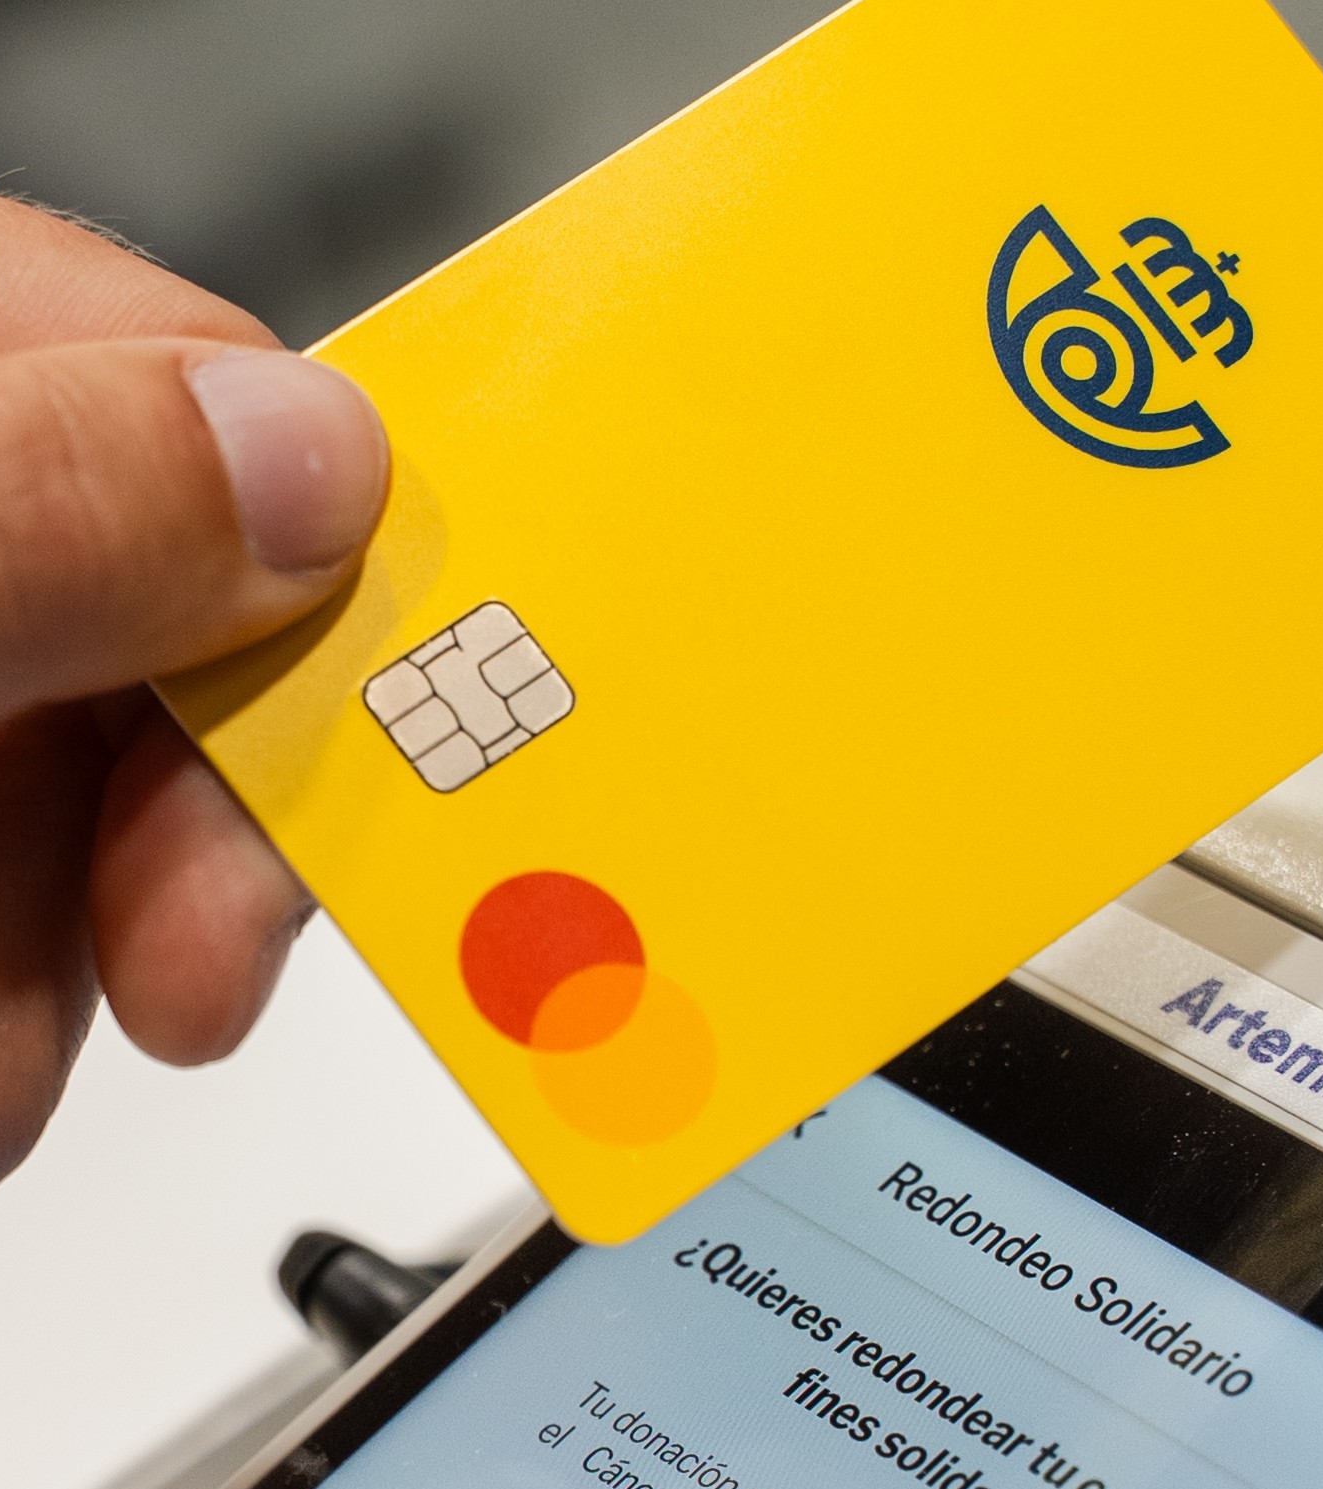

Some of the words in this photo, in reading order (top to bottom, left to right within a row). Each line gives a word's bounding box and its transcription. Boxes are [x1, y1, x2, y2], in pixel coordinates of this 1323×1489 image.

[879, 1160, 1074, 1291] Redondeo
[1074, 1276, 1255, 1399] Solidario
[578, 1380, 616, 1421] Tu
[674, 1237, 842, 1344] ¿Quieres
[835, 1330, 1036, 1458] redondear
[1028, 1441, 1079, 1489] tu
[538, 1422, 577, 1449] el
[782, 1368, 882, 1443] fines
